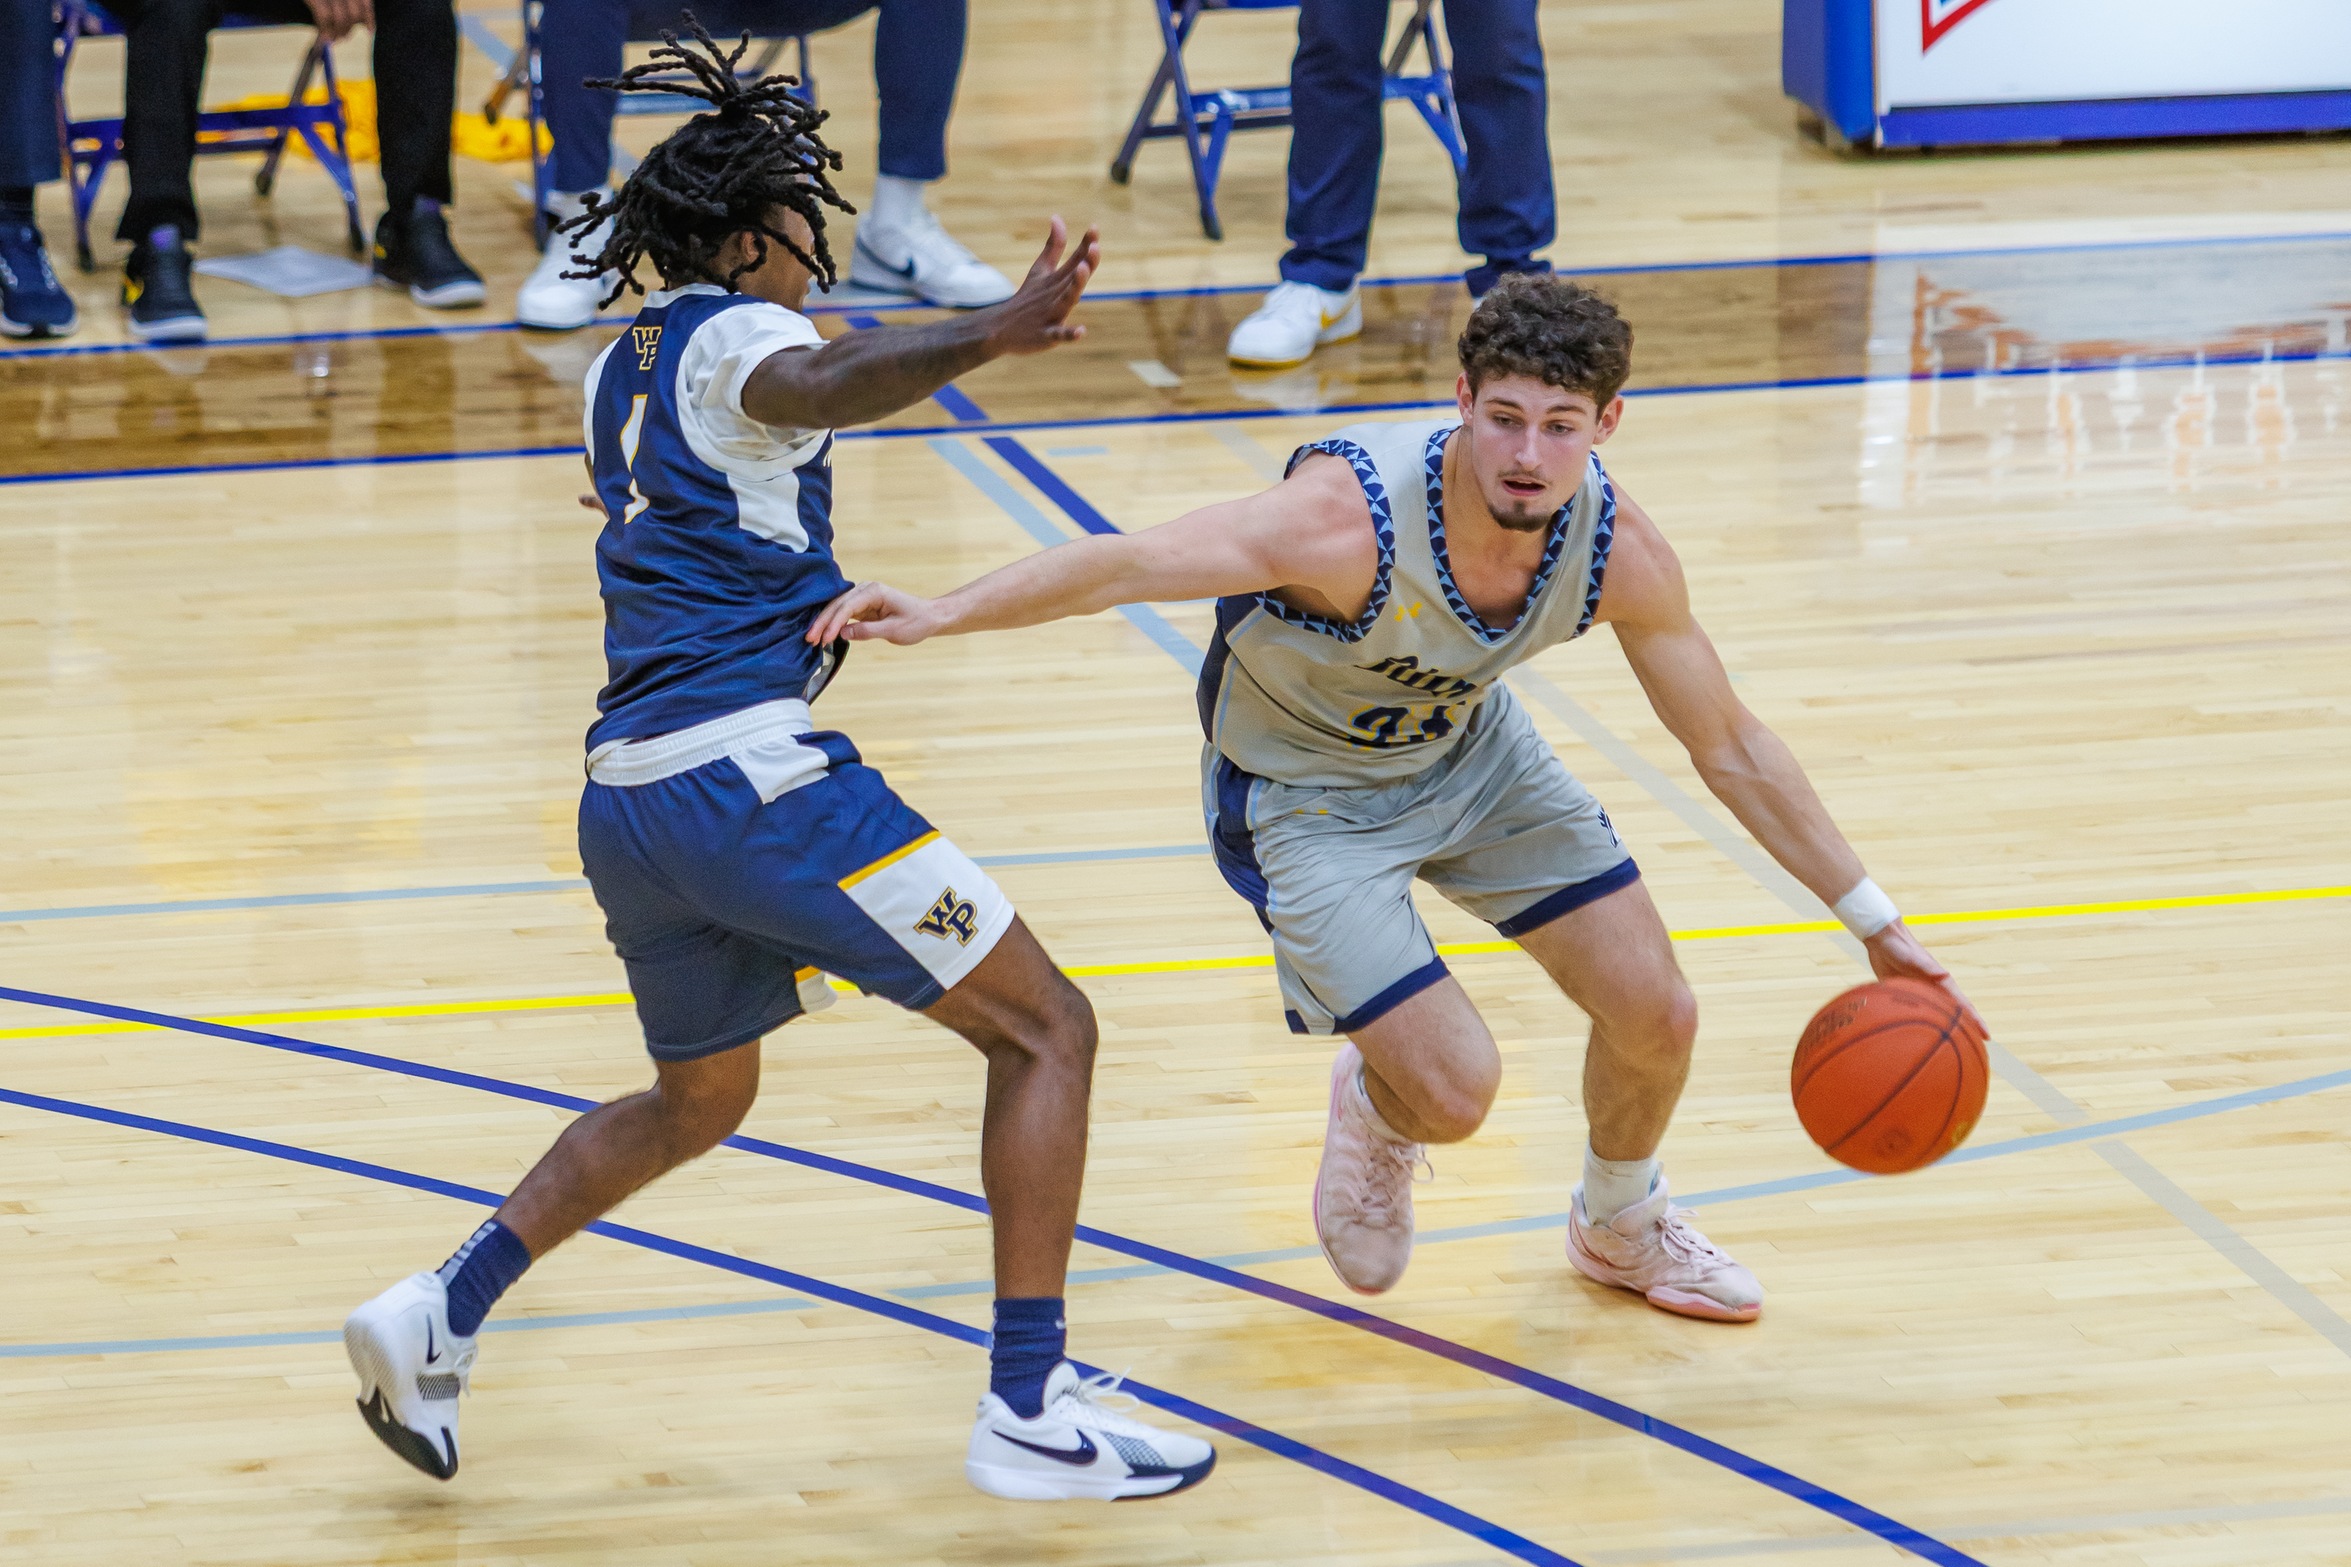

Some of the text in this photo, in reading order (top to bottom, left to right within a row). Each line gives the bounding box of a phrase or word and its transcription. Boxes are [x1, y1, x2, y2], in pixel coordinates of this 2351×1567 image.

[632, 326, 662, 371] WP
[620, 394, 649, 524] 1
[913, 885, 979, 948] WP
